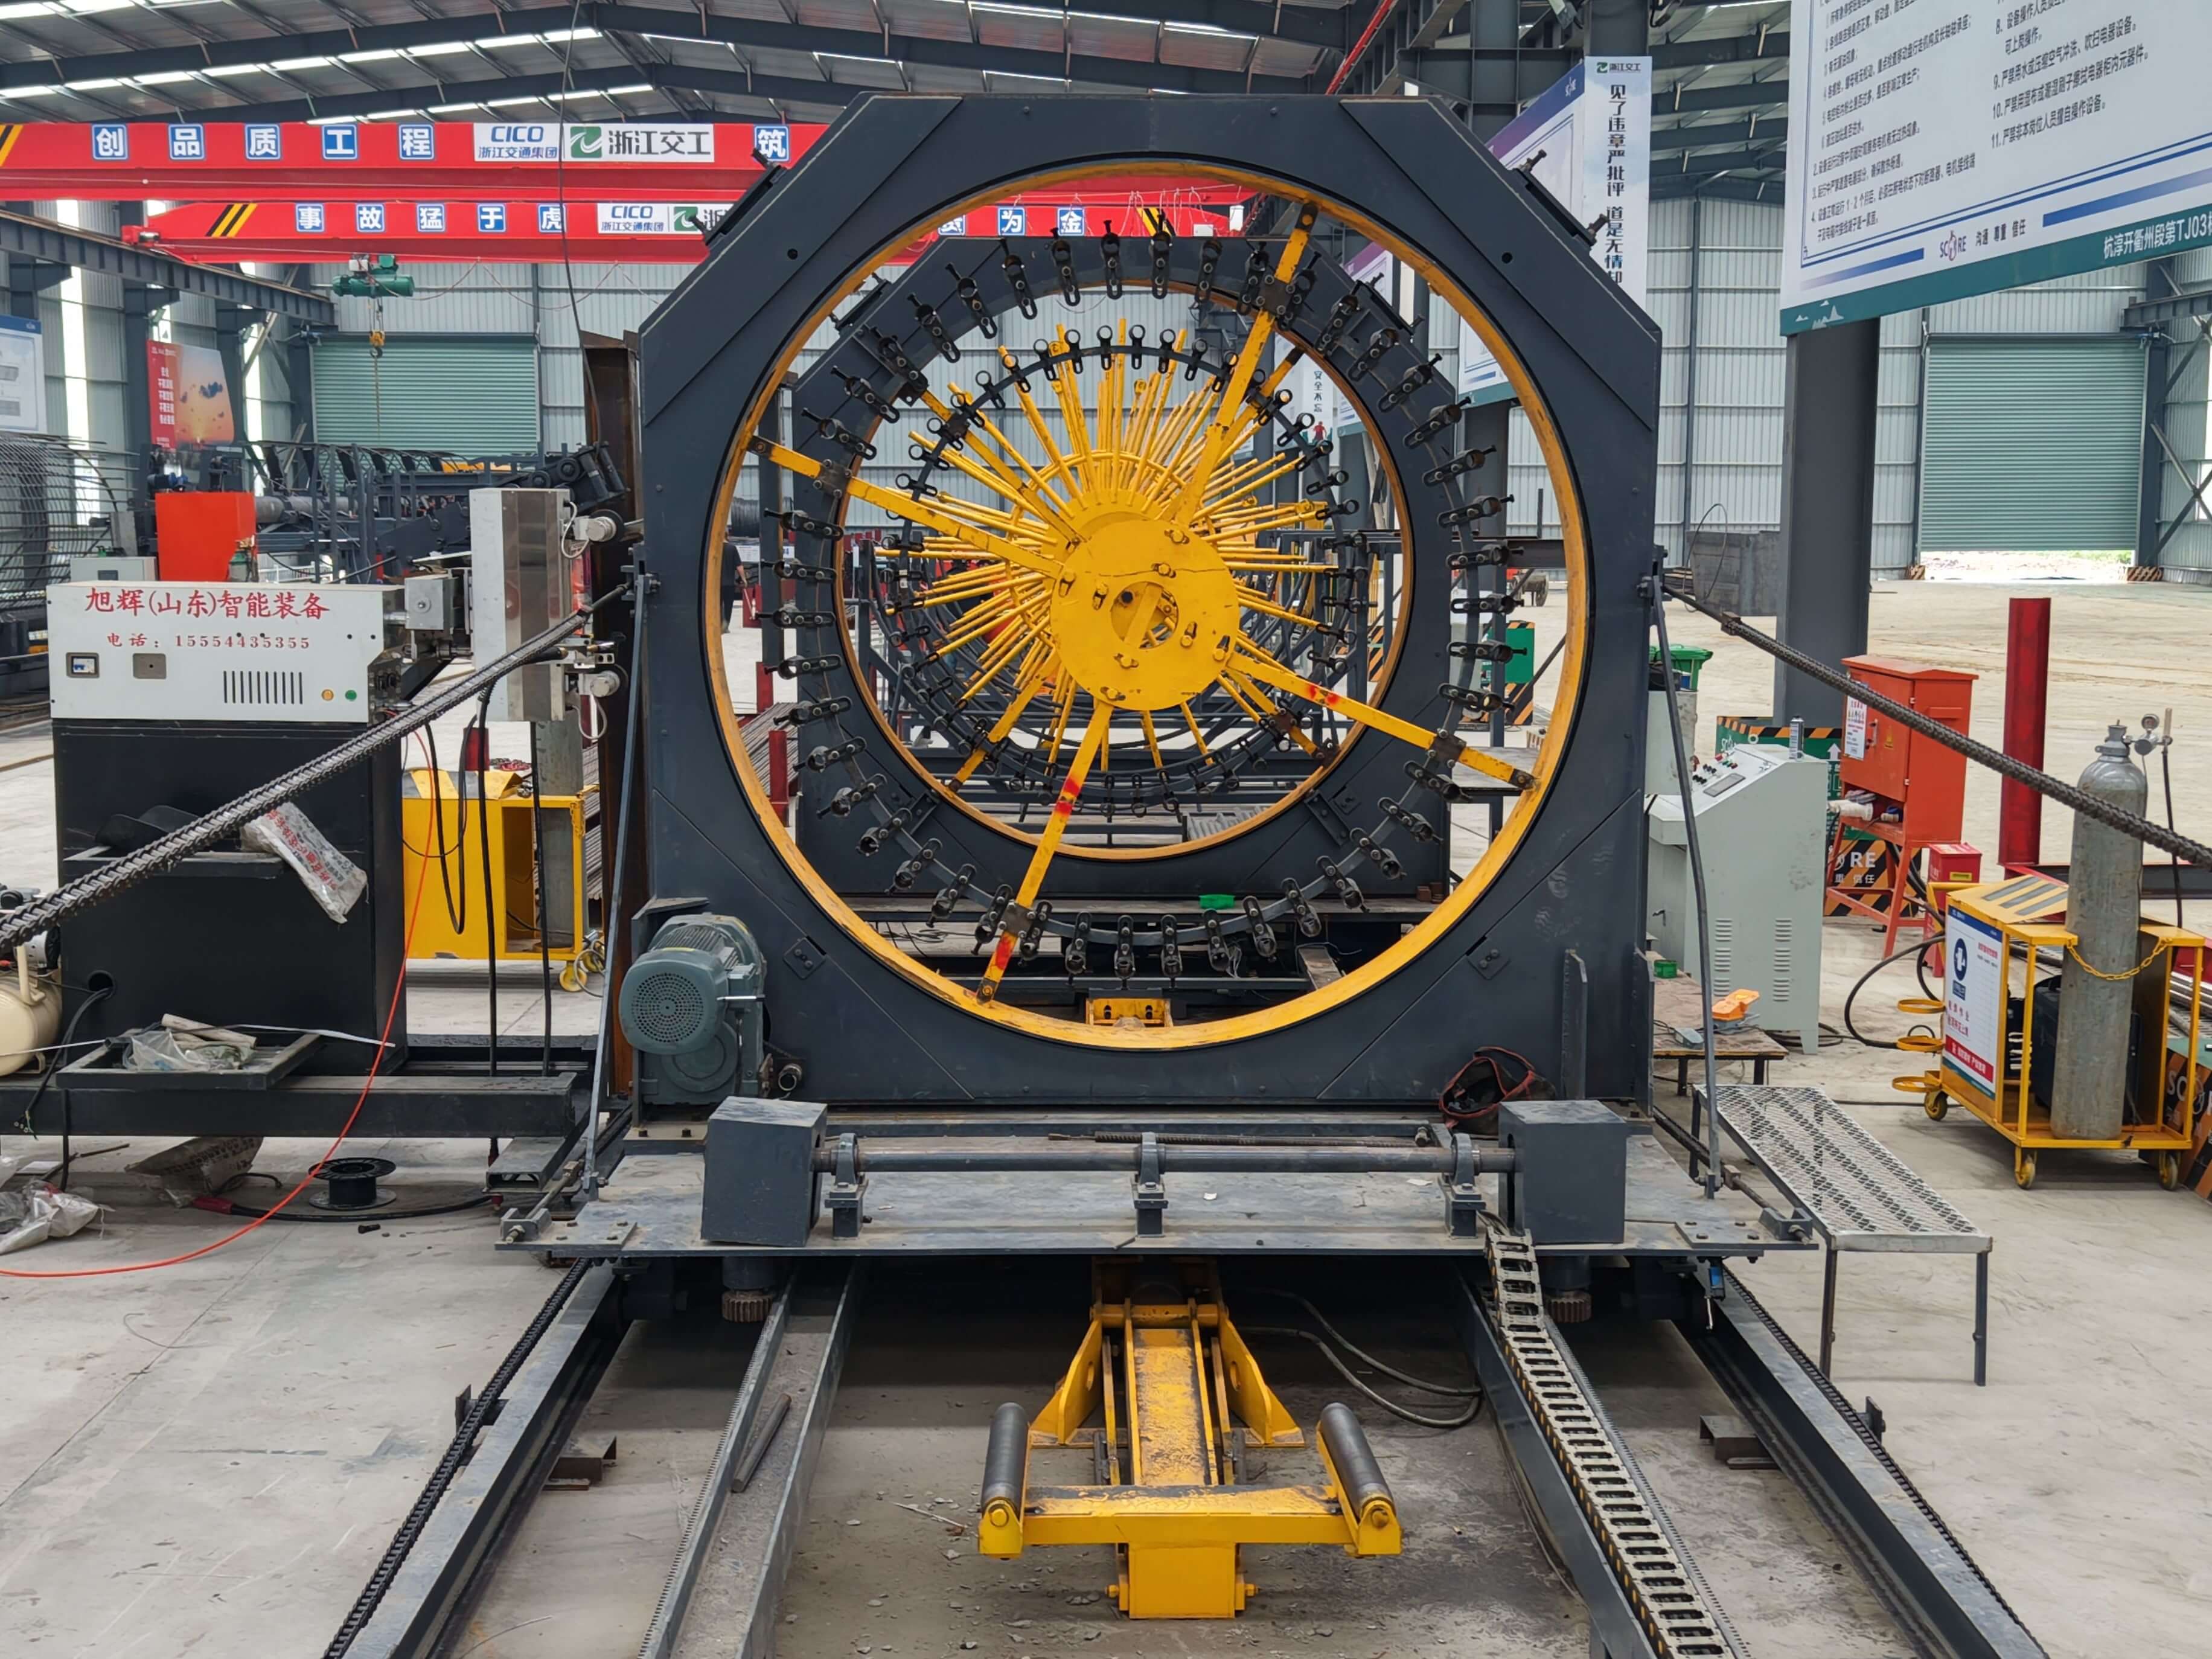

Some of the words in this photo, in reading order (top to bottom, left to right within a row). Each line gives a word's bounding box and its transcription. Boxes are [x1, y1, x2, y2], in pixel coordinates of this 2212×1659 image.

[96, 127, 433, 158] 创品质工程
[491, 126, 544, 143] CICO
[609, 130, 711, 156] 浙江交工
[756, 129, 786, 159] 筑
[478, 146, 558, 159] 浙江交通集团
[298, 206, 564, 230] 事故猛于虎
[611, 205, 653, 219] CICO
[601, 222, 664, 232] 浙江交通集团
[85, 587, 330, 620] 旭辉(山东)智能装备
[175, 635, 310, 650] 15554435355
